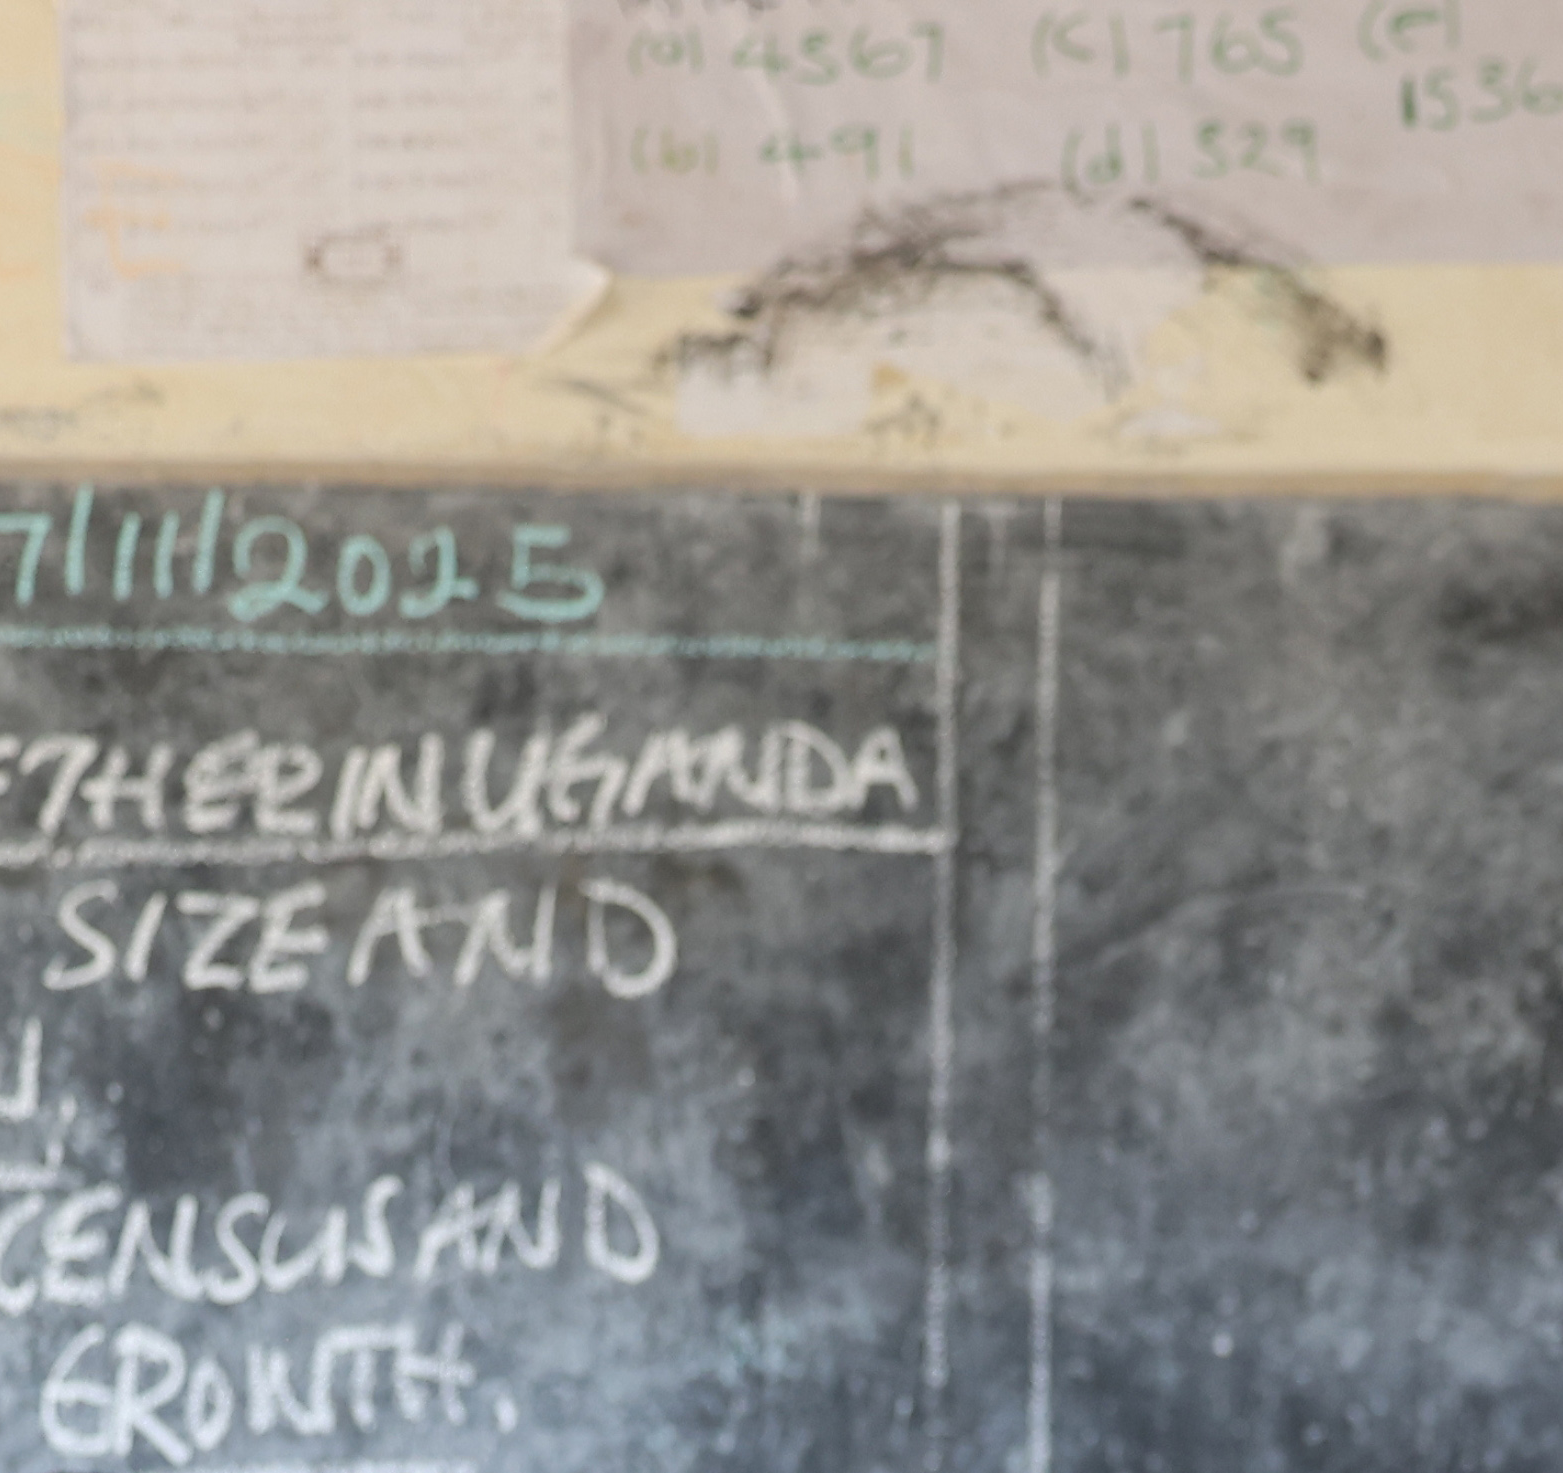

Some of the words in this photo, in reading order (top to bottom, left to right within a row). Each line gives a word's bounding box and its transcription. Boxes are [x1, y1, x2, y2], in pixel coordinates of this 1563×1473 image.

[42, 876, 330, 994] SIZE
[346, 876, 680, 1000] AND
[410, 1156, 662, 1286] AND
